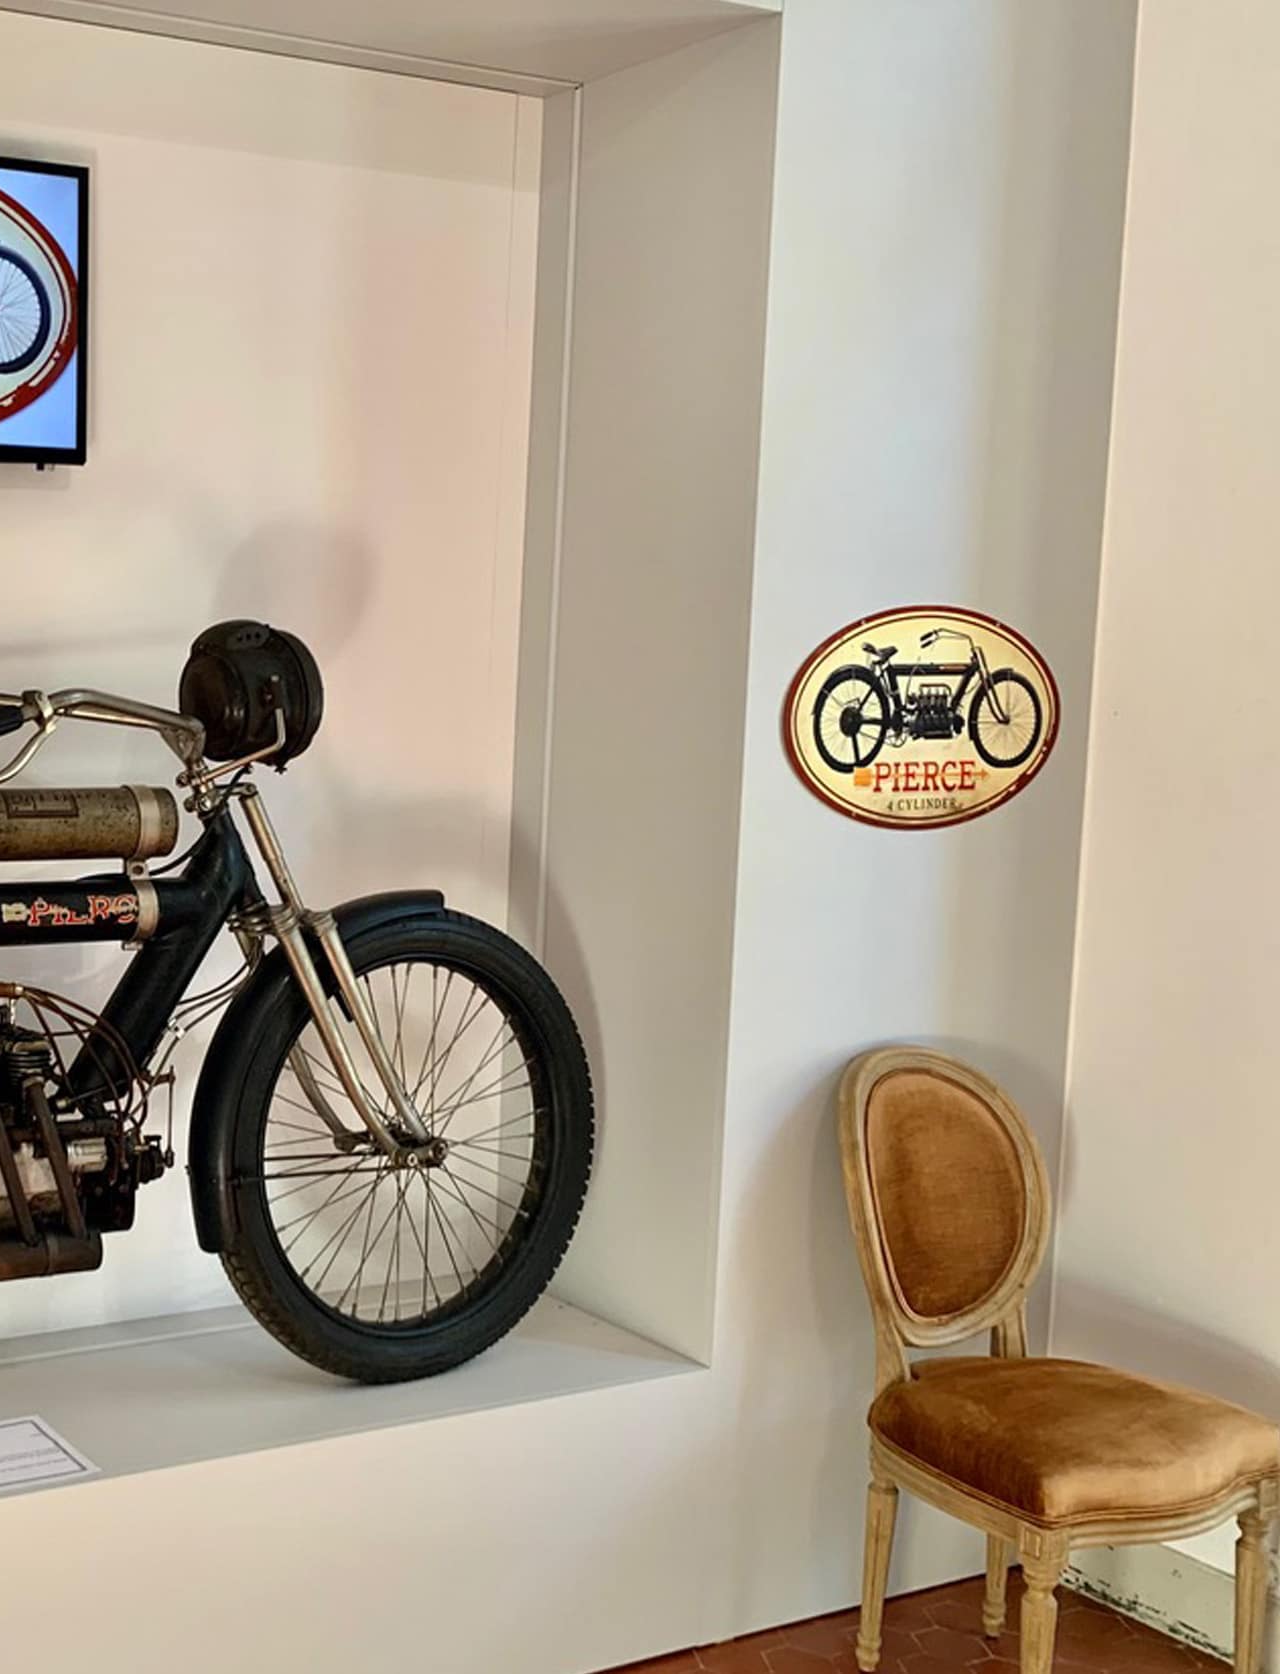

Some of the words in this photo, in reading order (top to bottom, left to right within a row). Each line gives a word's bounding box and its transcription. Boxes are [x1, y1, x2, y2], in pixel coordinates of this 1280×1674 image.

[873, 760, 976, 793] PIERCE
[887, 801, 894, 811] 4
[898, 798, 957, 811] CYLINDER
